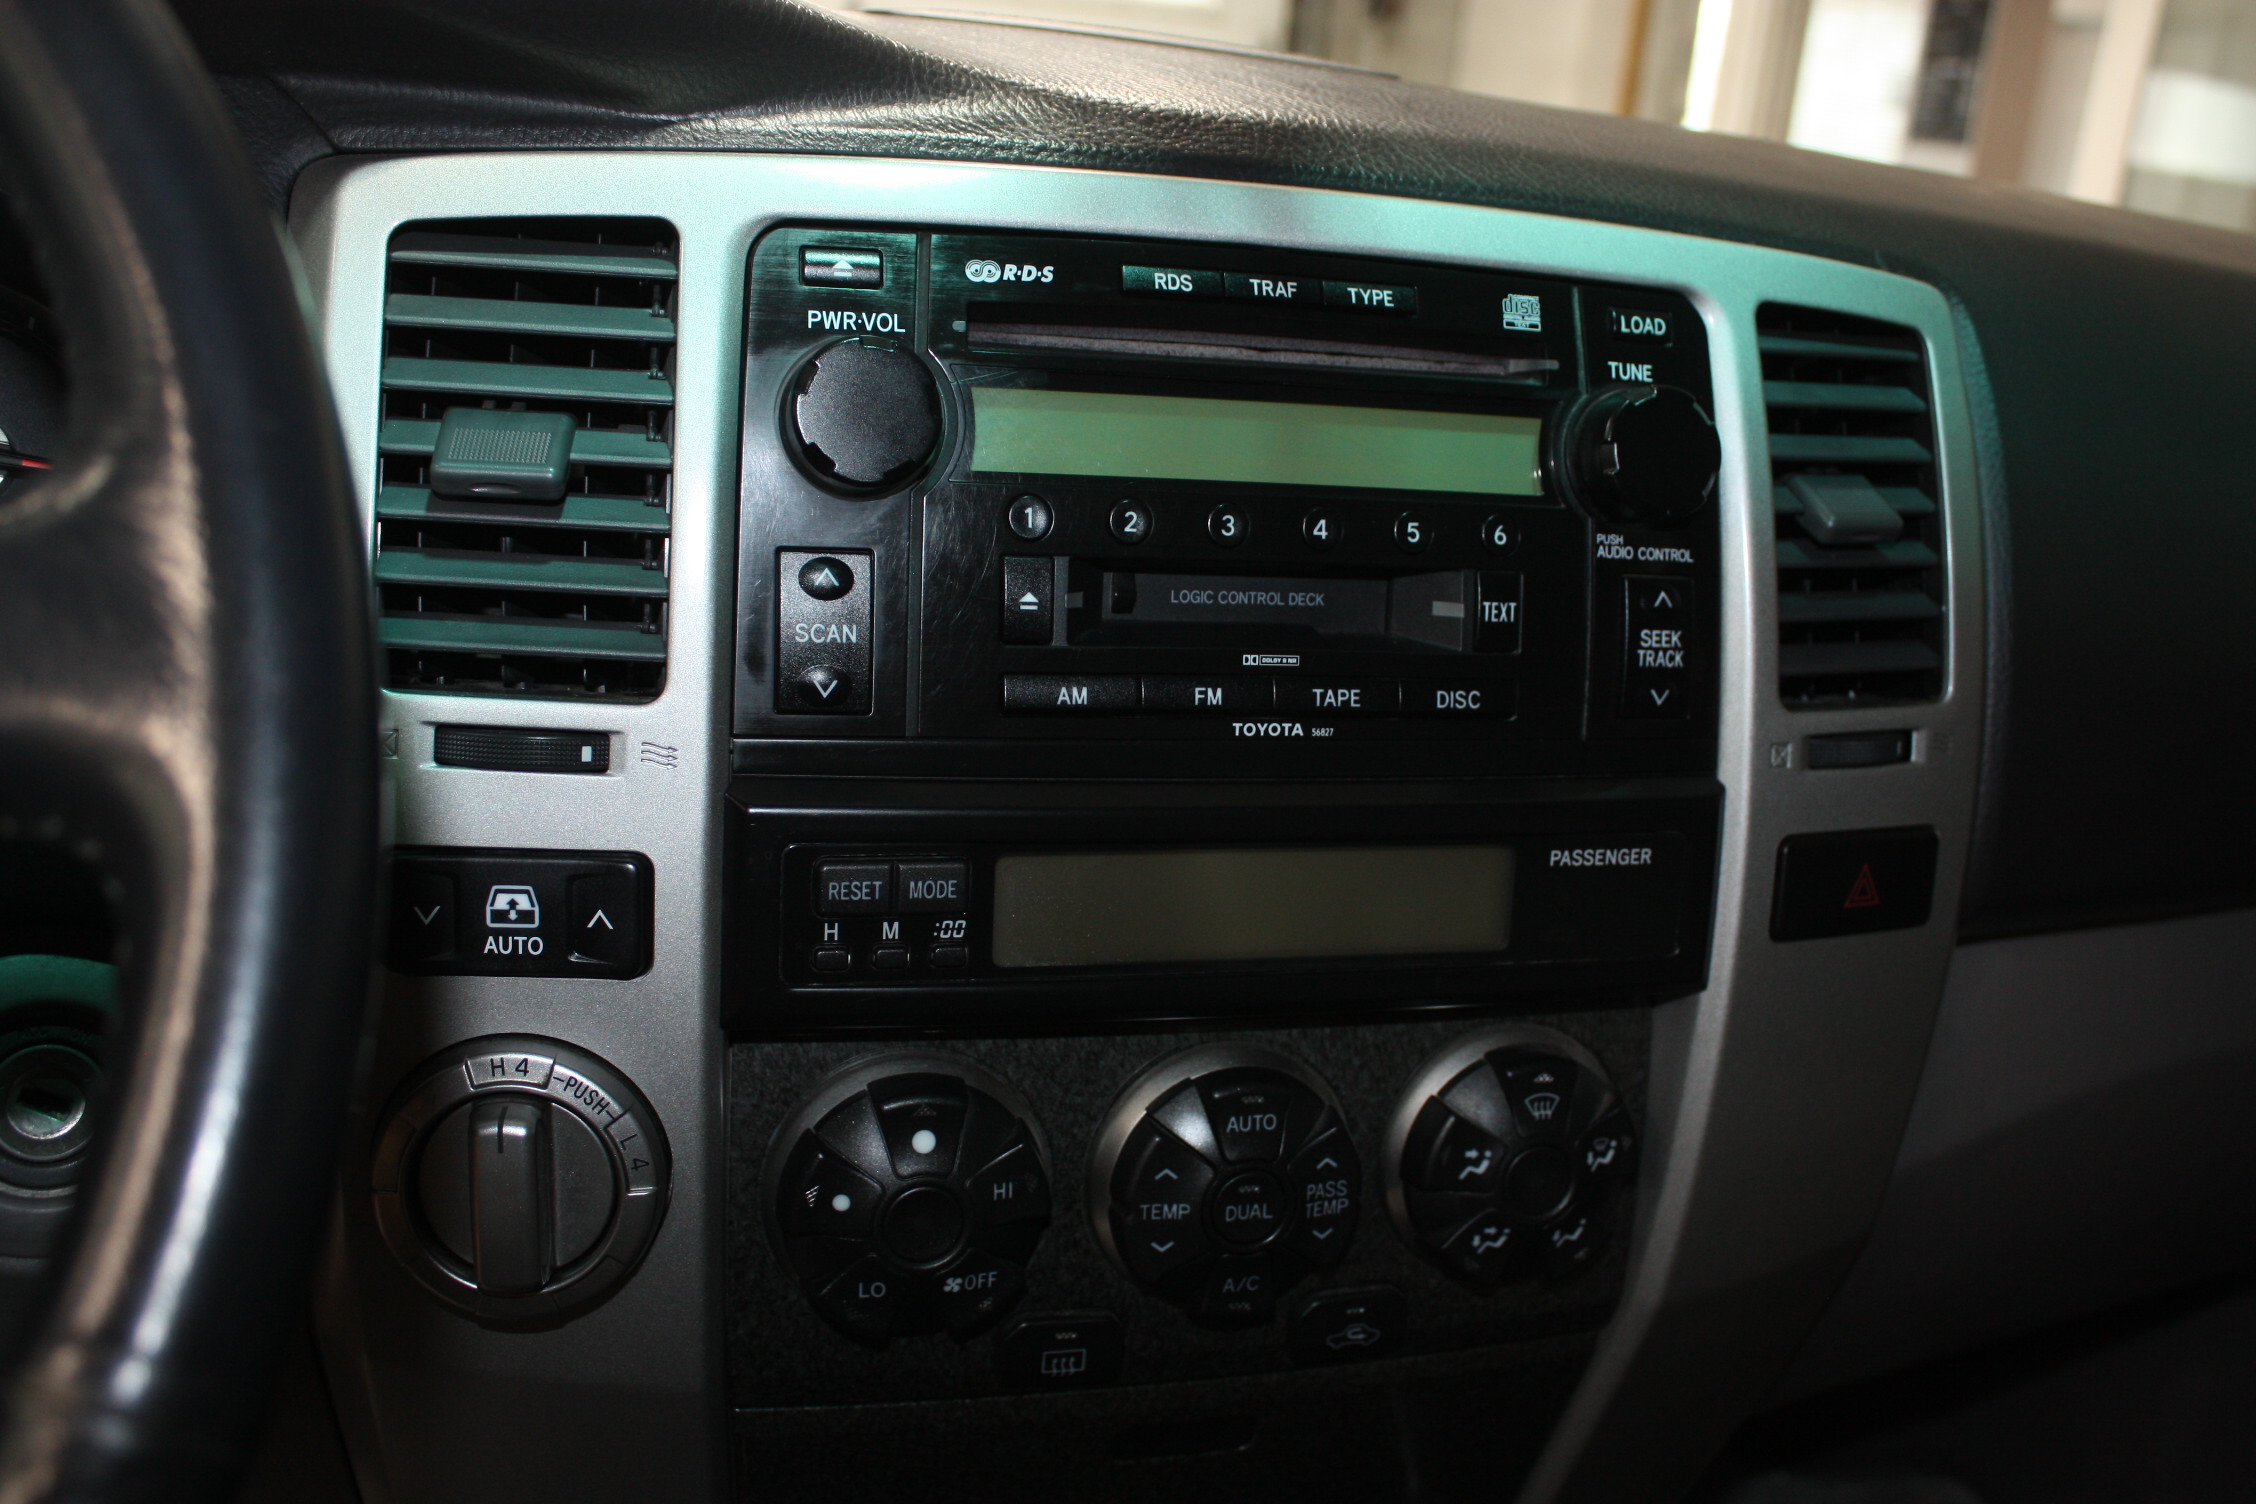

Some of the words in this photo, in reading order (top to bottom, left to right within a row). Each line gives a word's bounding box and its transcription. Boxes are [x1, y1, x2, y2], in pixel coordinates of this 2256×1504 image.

[1154, 273, 1193, 292] RDS
[1250, 279, 1298, 298] TRAF
[1347, 287, 1395, 307] TYPE
[1621, 314, 1667, 336] LOAD
[1608, 361, 1654, 382] TUNE
[1024, 507, 1034, 528] 1
[1124, 511, 1138, 532] 2
[1221, 515, 1235, 536] 3
[1312, 519, 1328, 540] 4
[1406, 522, 1421, 543] 5
[1493, 525, 1507, 546] 6
[1596, 533, 1624, 544] PUSH
[1596, 545, 1634, 560] AUDIO
[1637, 546, 1694, 563] CONTROL
[1170, 589, 1214, 605] LOGIC
[1218, 590, 1285, 606] CONTROL
[1288, 592, 1325, 607] DECK
[1482, 601, 1517, 622] TEXT
[795, 624, 857, 644] SCAN
[1640, 629, 1682, 648] SEEK
[1637, 649, 1684, 669] TRACK
[1057, 687, 1088, 705] AM
[1194, 687, 1223, 706] FM
[1312, 688, 1361, 708] TAPE
[1436, 690, 1481, 710] DISC
[1232, 722, 1304, 738] TOYOTA
[1311, 727, 1334, 738] 56827
[1549, 848, 1653, 867] PASSENGER
[828, 881, 882, 900] RESET
[909, 880, 958, 899] MODE
[823, 922, 839, 941] H
[882, 921, 899, 940] M
[483, 936, 544, 956] AUTO
[1226, 1113, 1278, 1133] AUTO
[993, 1181, 1014, 1200] HI
[1306, 1180, 1348, 1199] PASS
[1139, 1203, 1191, 1220] TEMP
[1225, 1204, 1274, 1222] DUAL
[1305, 1199, 1349, 1219] TEMP
[858, 1282, 886, 1298] LO
[964, 1271, 998, 1291] OFF
[1221, 1275, 1261, 1294] A/C
